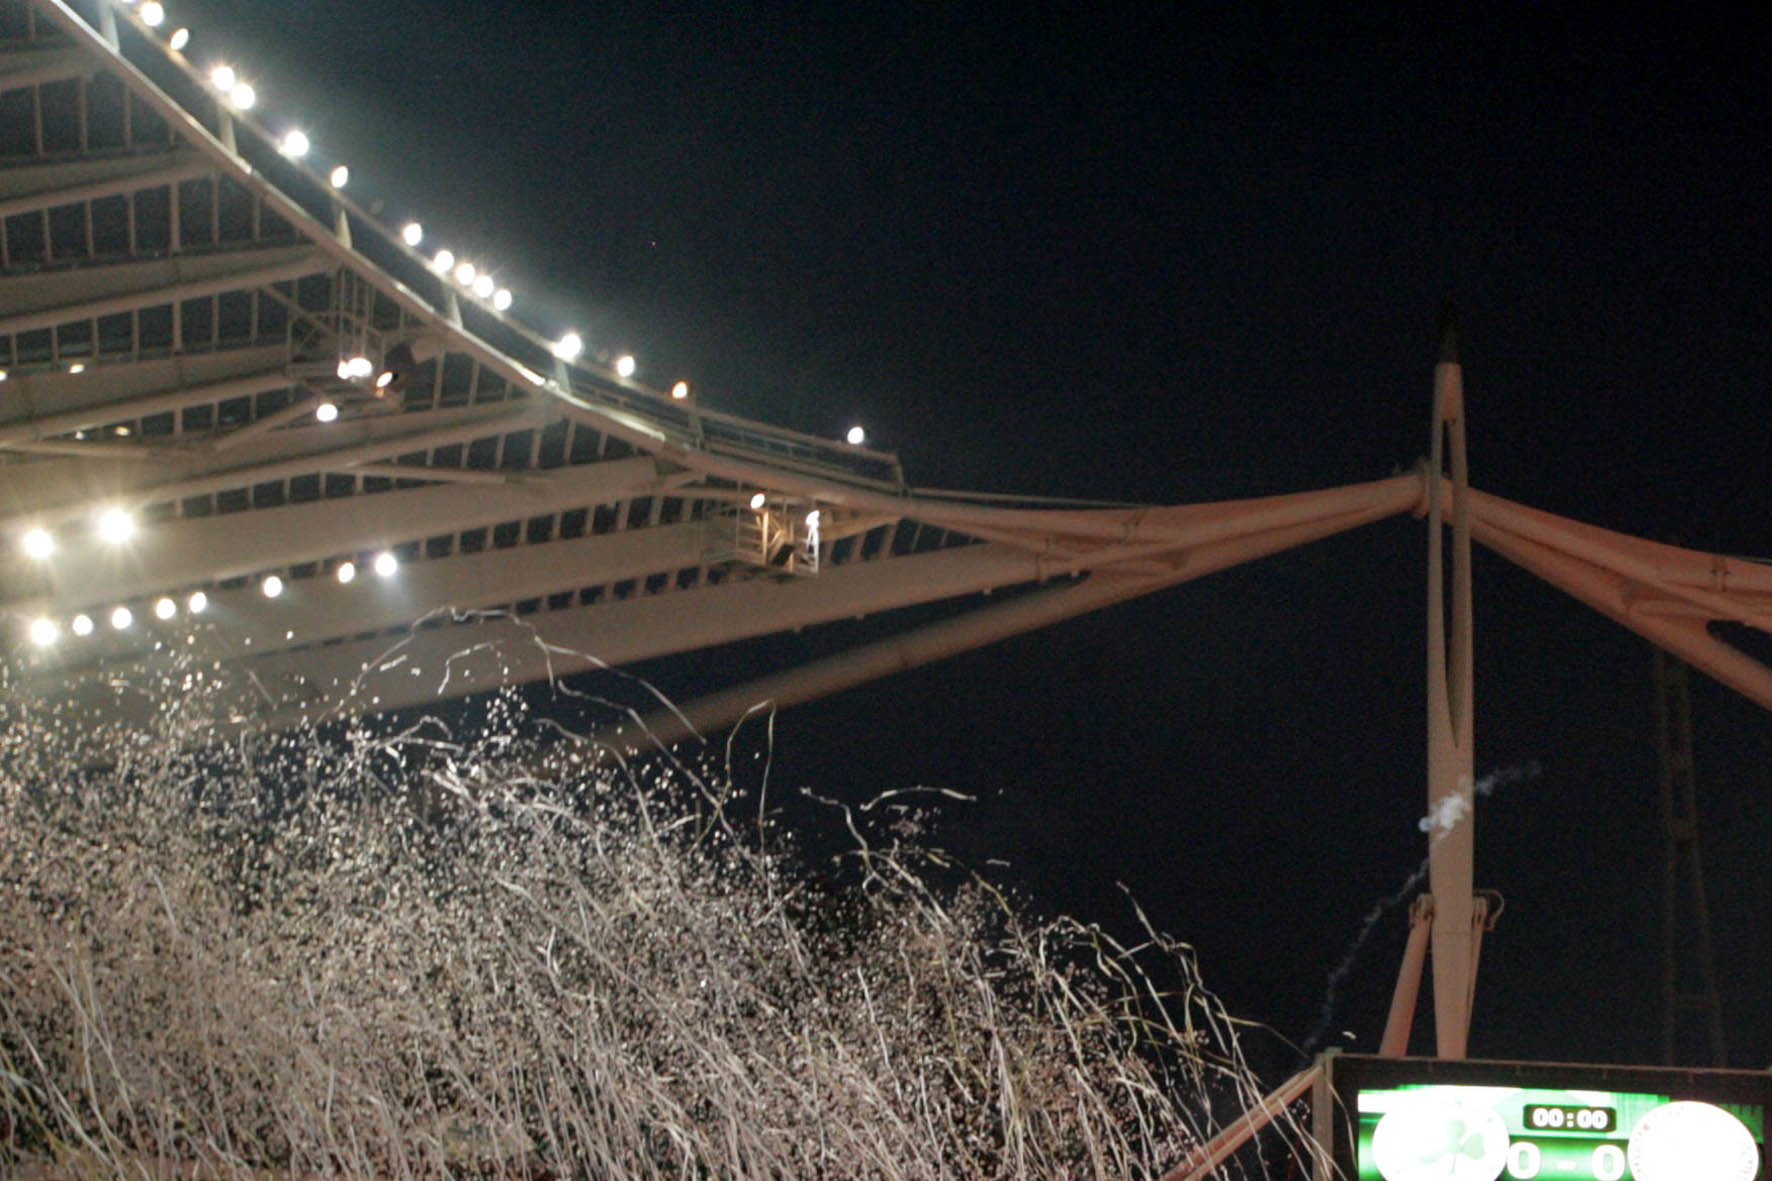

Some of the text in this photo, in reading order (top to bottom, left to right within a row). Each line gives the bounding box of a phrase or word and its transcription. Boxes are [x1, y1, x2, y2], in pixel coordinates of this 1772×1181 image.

[1532, 1107, 1608, 1128] 00:00
[1507, 1141, 1541, 1180] 0
[1591, 1144, 1626, 1181] 0
